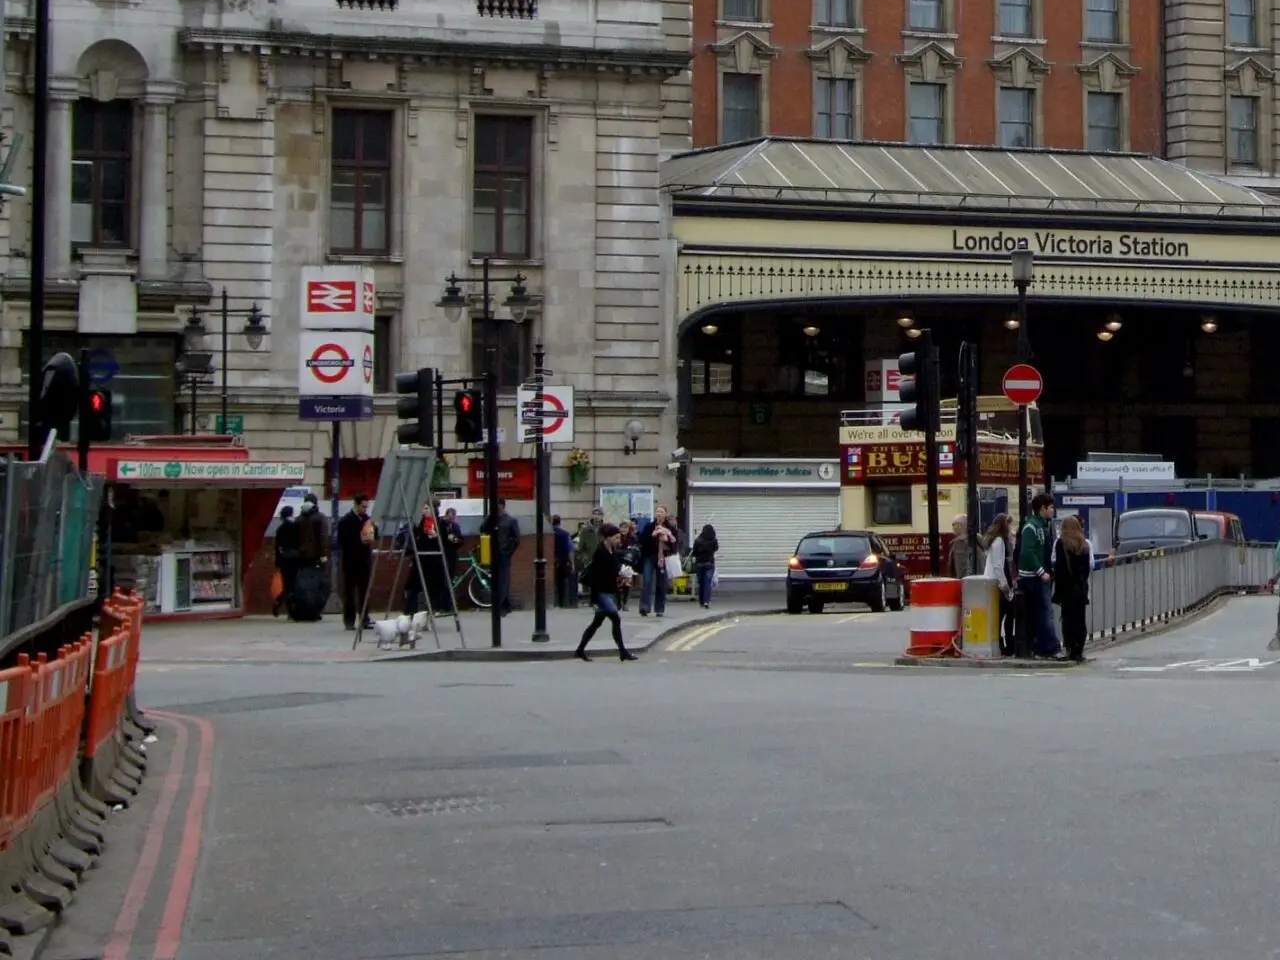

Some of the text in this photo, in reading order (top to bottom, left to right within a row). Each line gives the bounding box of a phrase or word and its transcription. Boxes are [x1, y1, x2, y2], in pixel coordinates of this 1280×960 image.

[1035, 231, 1113, 254] Victoria
[1119, 234, 1189, 257] Station
[314, 405, 346, 413] Victoria
[848, 428, 873, 440] We're
[877, 428, 888, 439] all
[892, 430, 912, 438] over
[866, 451, 927, 467] BUS
[138, 464, 161, 476] 100m
[184, 463, 204, 474] Now
[206, 464, 230, 477] open
[232, 463, 240, 474] in
[243, 463, 278, 475] Cardinal
[281, 463, 304, 475] Place
